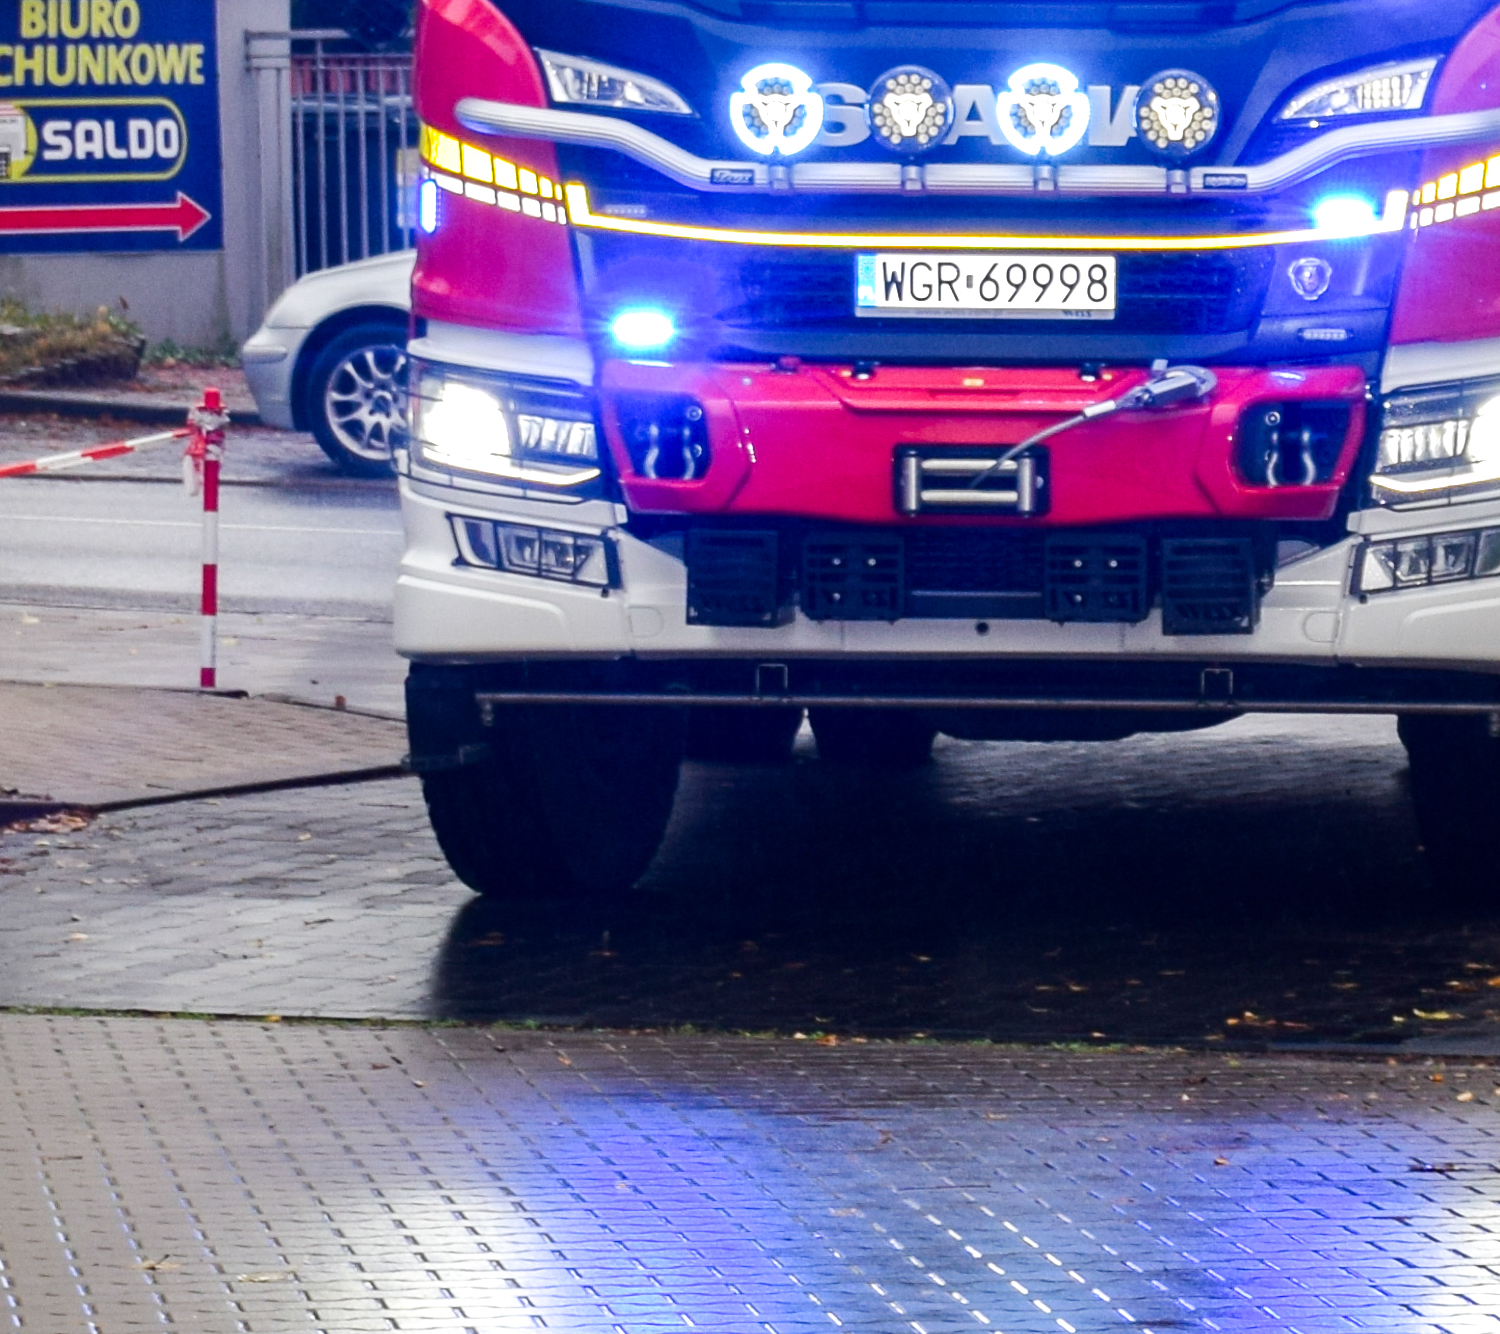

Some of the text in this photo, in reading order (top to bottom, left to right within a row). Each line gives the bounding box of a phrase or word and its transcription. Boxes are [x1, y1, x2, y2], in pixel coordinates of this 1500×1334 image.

[42, 119, 181, 162] SALDO
[882, 262, 1108, 303] WGR 69998
